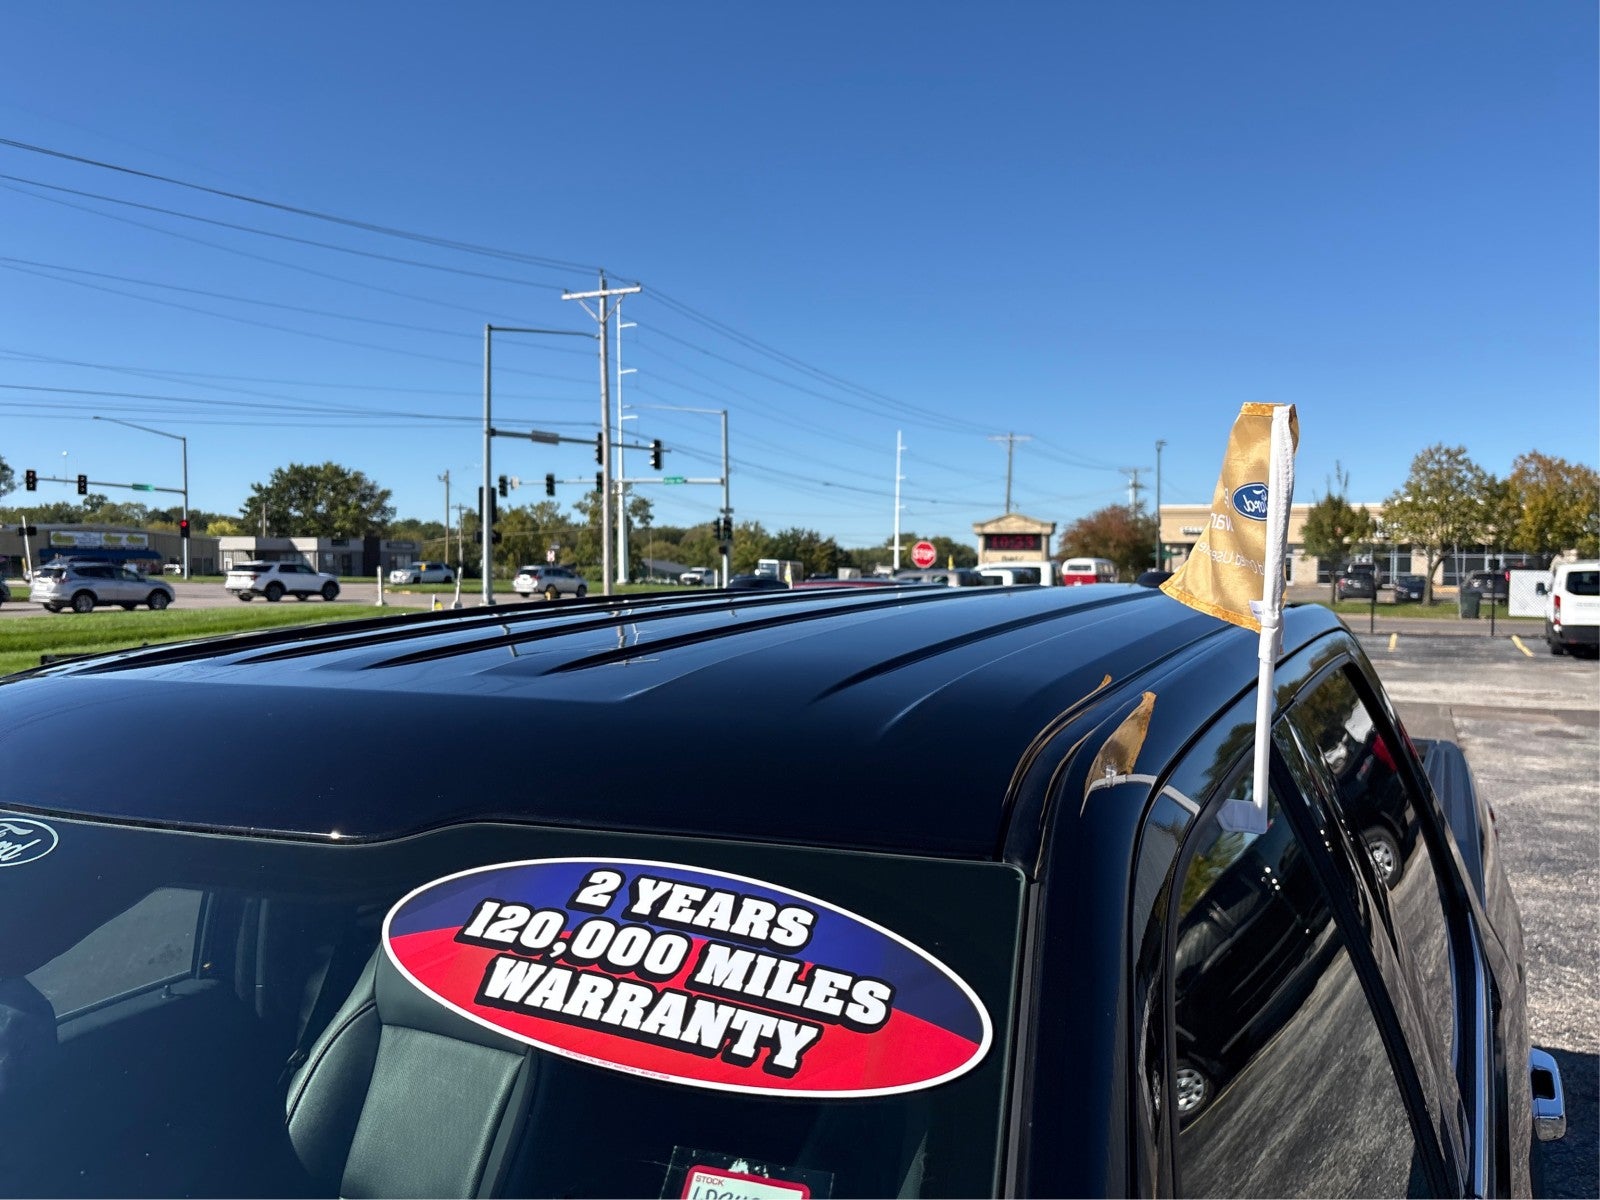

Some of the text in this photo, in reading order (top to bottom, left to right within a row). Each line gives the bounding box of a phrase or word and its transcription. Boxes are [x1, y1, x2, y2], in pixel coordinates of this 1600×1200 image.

[912, 549, 935, 560] STOP
[576, 870, 814, 948] 2 YEARS
[465, 901, 892, 1026] 120,000 MILES
[483, 956, 819, 1070] WARRANTY
[695, 1174, 725, 1187] STOCK
